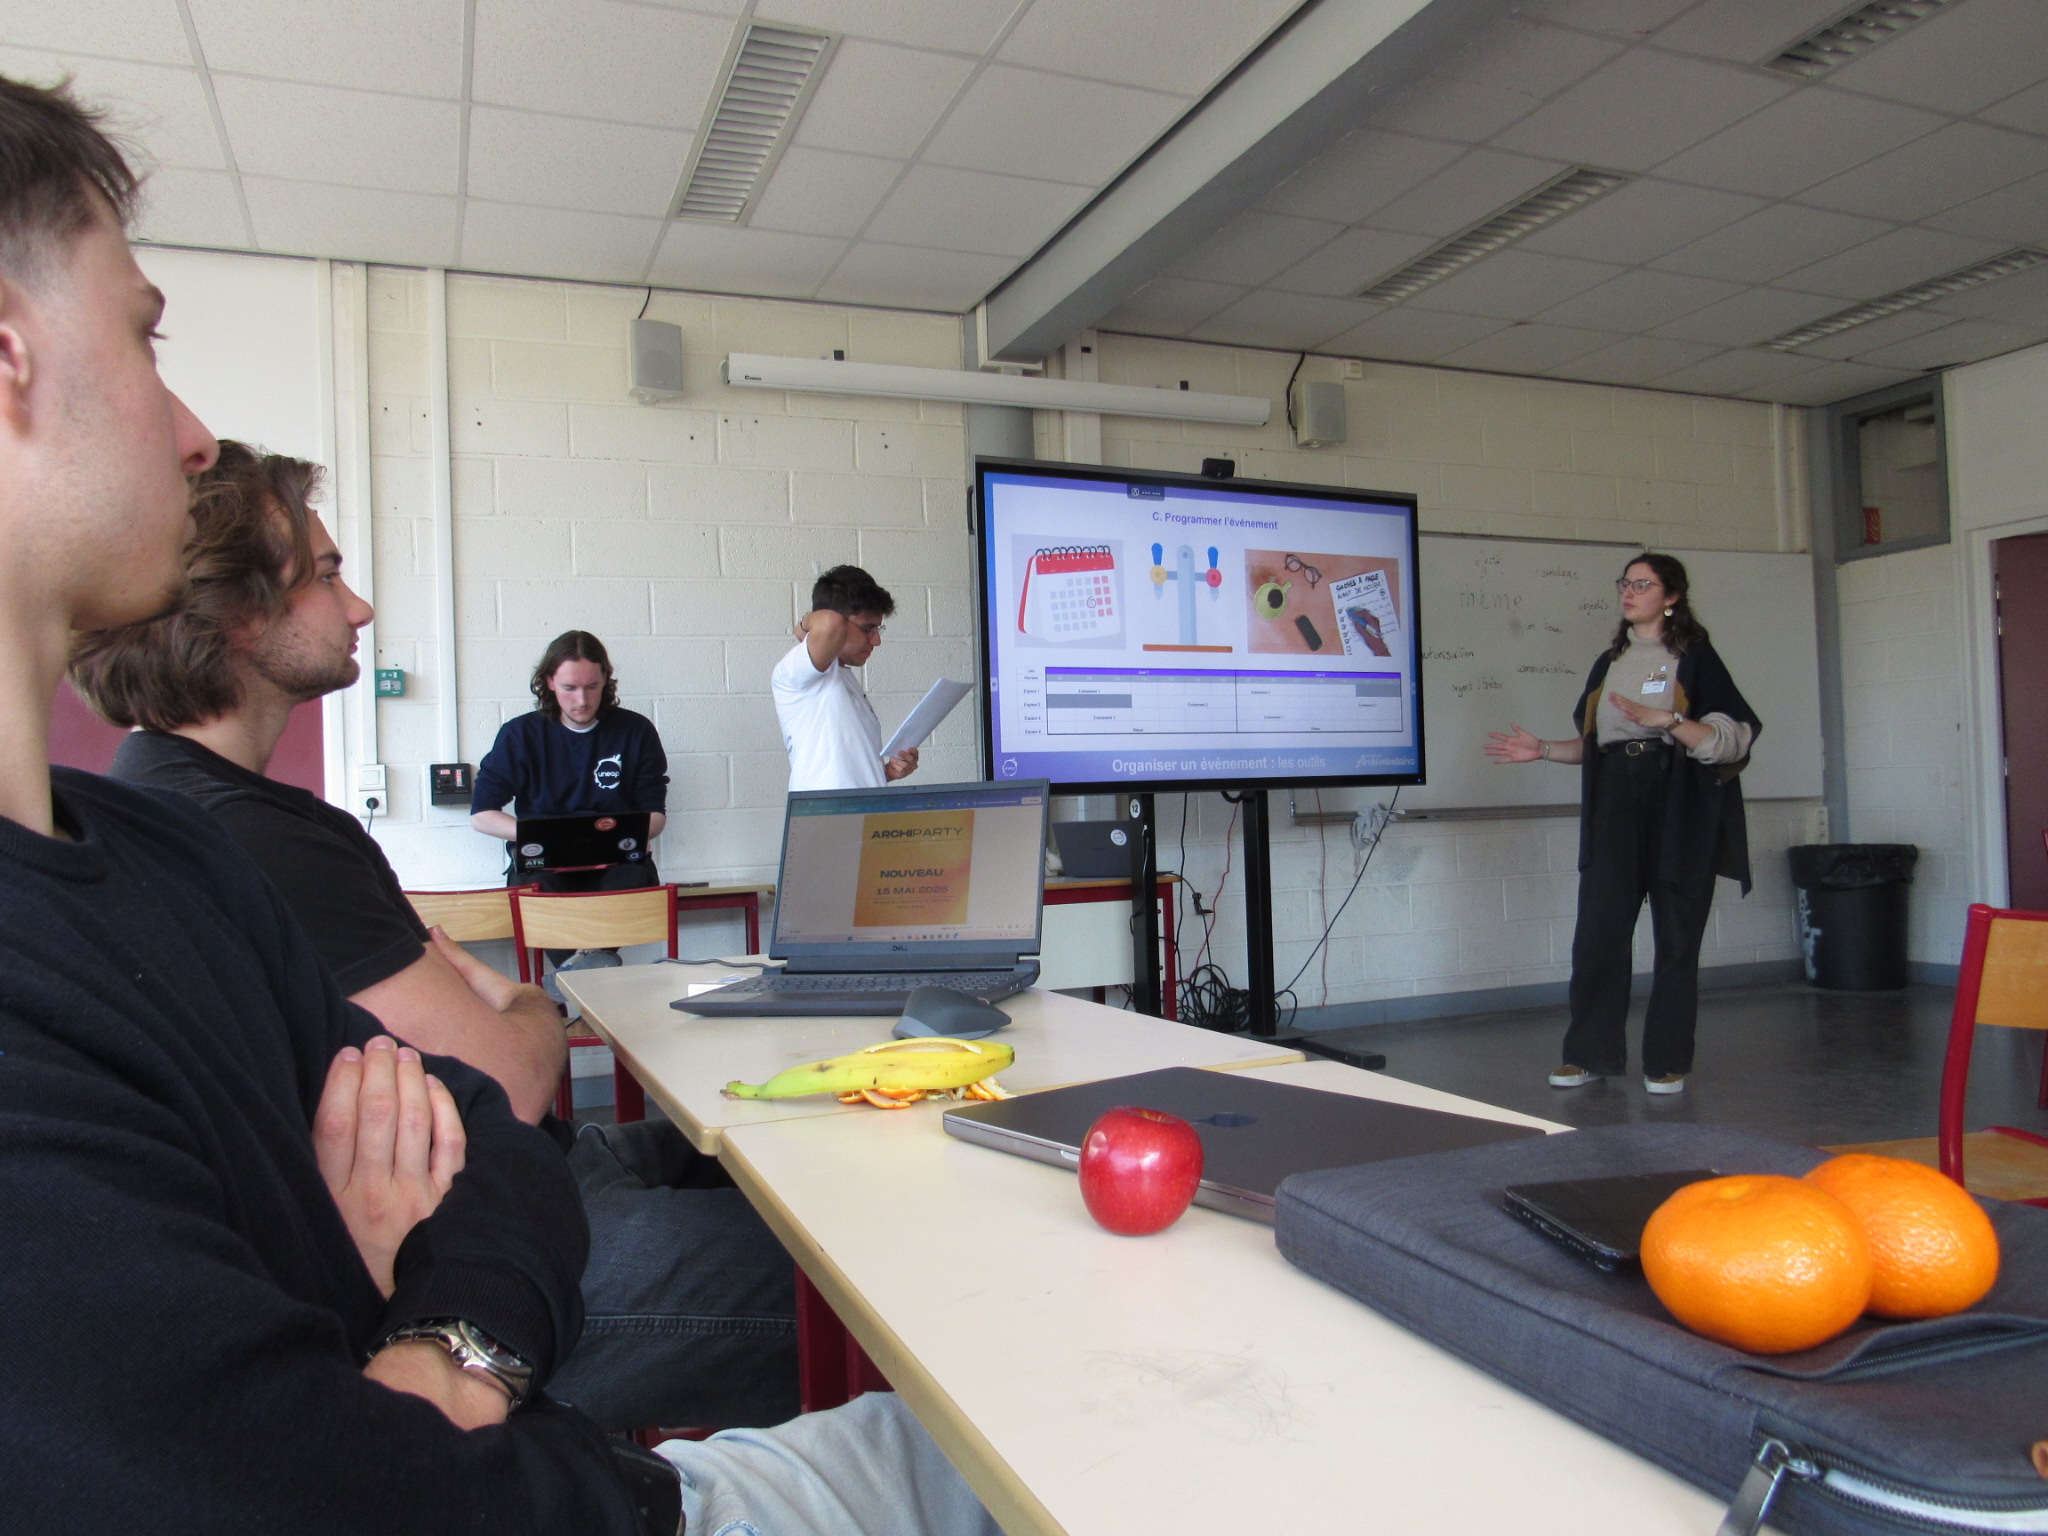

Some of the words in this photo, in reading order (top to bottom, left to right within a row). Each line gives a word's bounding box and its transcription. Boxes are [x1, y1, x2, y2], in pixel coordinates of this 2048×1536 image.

[1152, 511, 1163, 522] C.
[1165, 512, 1222, 526] Programmer
[1224, 516, 1278, 530] l'événement
[1112, 758, 1177, 775] Organiser
[1180, 759, 1197, 771] un
[1200, 756, 1267, 770] évènement
[1277, 755, 1294, 769] les
[1297, 754, 1326, 768] outils
[1131, 804, 1139, 813] 12
[871, 827, 963, 839] ARCHIPARTY
[880, 869, 944, 878] NOUVEAU
[876, 887, 890, 895] 15
[918, 885, 949, 894] 2025
